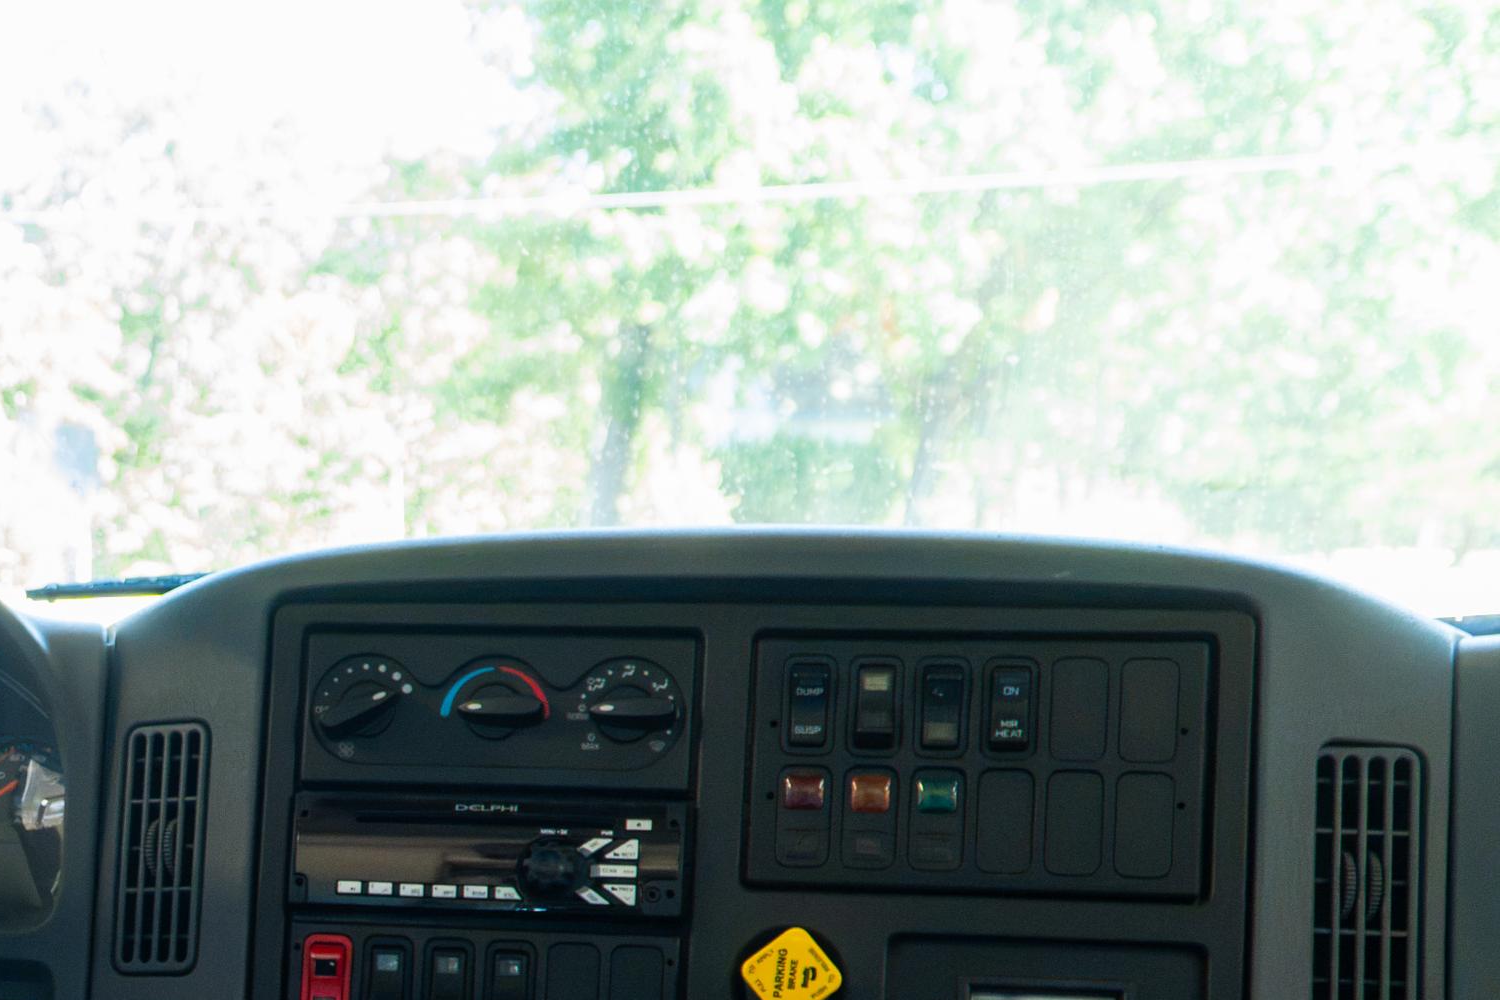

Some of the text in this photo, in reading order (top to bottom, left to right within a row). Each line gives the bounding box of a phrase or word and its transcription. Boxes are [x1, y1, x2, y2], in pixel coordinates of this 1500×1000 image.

[1002, 686, 1020, 697] ON
[995, 728, 1024, 738] HEAT
[454, 803, 519, 813] DELPHI
[772, 948, 788, 999] PARKING
[786, 959, 799, 990] BRAKE
[800, 965, 818, 989] P
